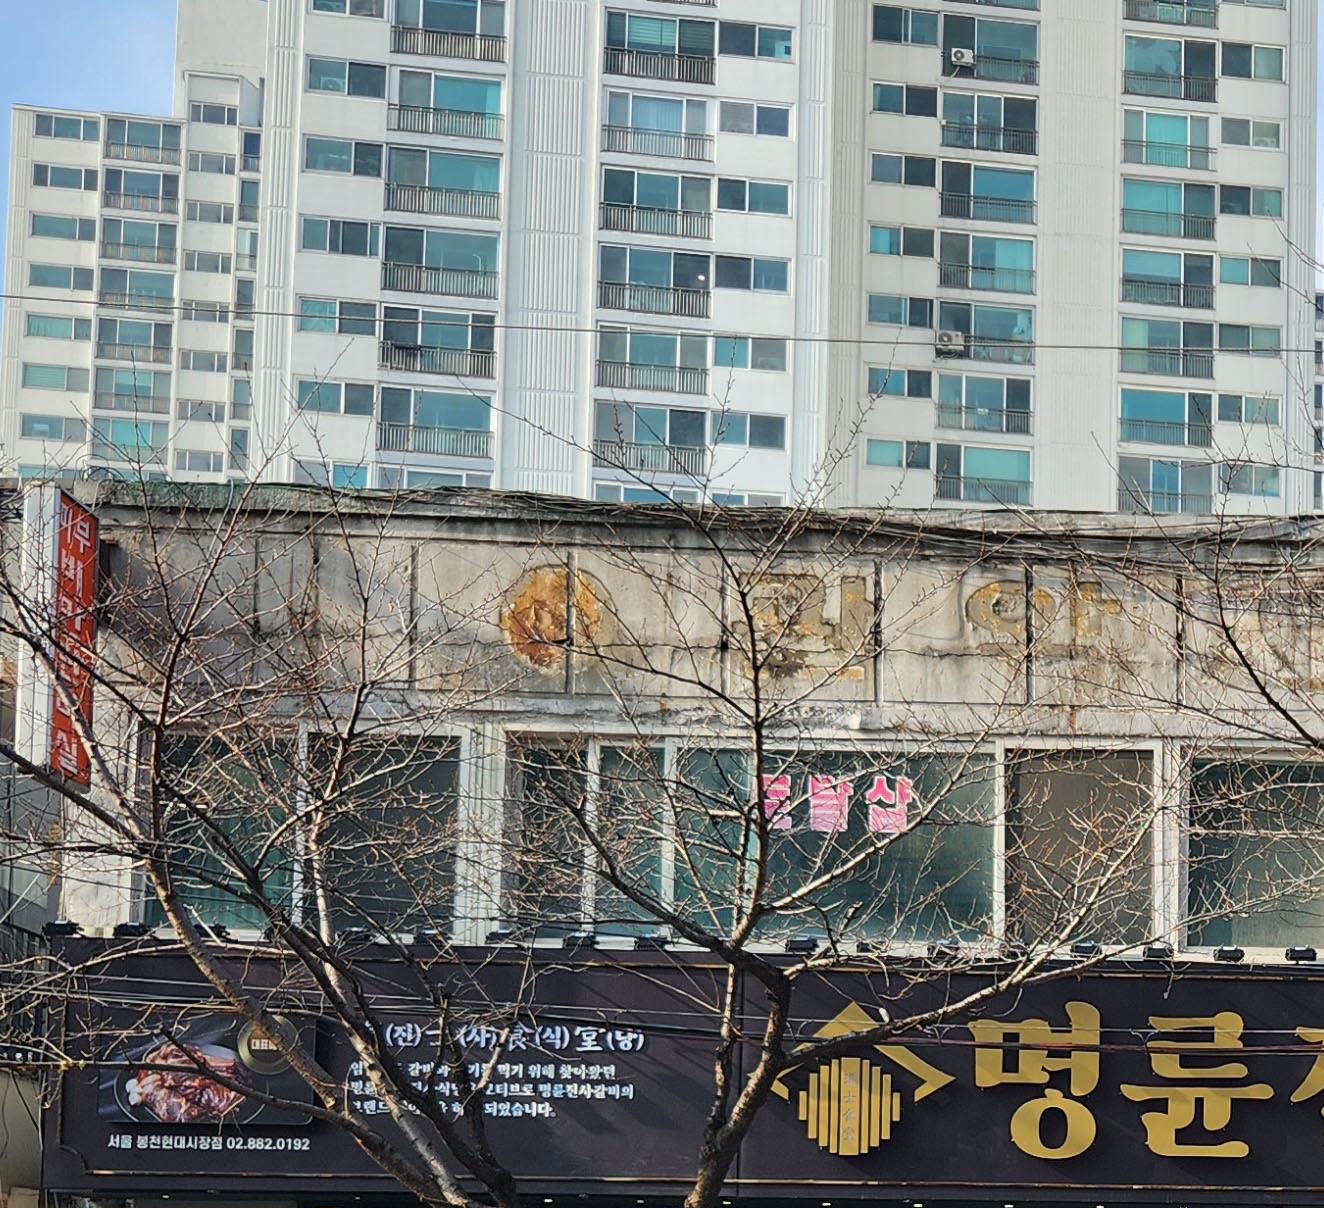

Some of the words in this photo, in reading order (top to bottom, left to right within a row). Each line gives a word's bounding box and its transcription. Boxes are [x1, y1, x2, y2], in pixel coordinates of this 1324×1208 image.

[497, 1063, 523, 1079] 먹기
[527, 1063, 555, 1079] 위해
[558, 1063, 617, 1080] 찾아왔던
[538, 1083, 634, 1099] 명륜진사갈비의
[484, 1101, 556, 1117] 되었습니다.
[107, 1134, 132, 1149] 서울
[136, 1134, 223, 1150] 봉천현대시장점
[226, 1137, 310, 1151] 02.882.0192
